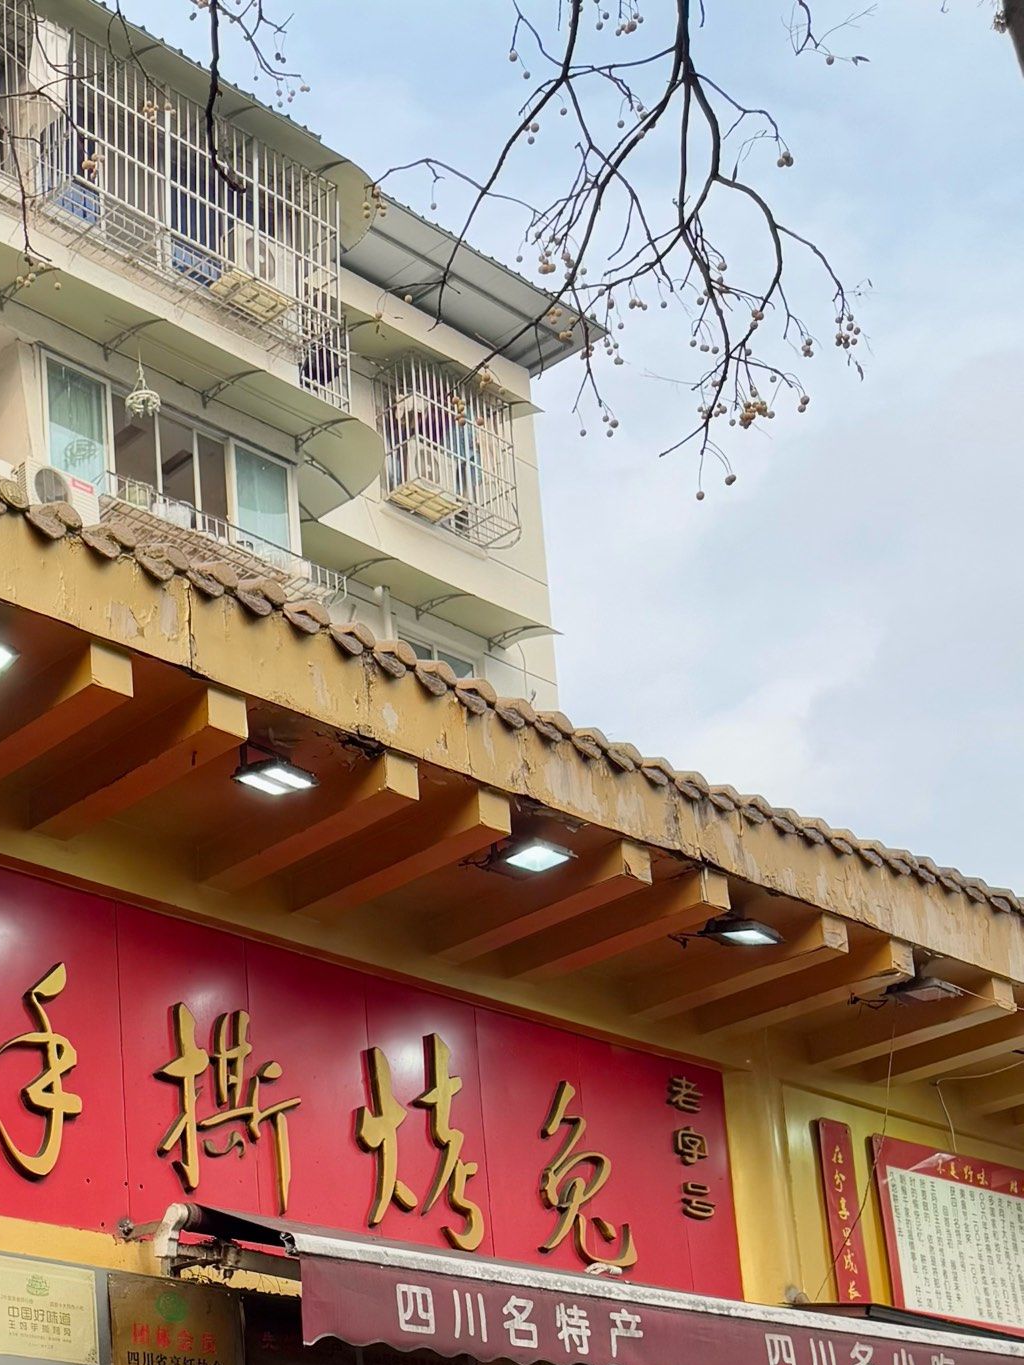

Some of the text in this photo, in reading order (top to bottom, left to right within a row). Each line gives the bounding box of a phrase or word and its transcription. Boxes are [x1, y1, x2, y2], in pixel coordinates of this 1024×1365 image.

[667, 1075, 716, 1220] 老字号
[7, 1305, 71, 1326] 中国好味道
[395, 1283, 645, 1360] 四川名特产
